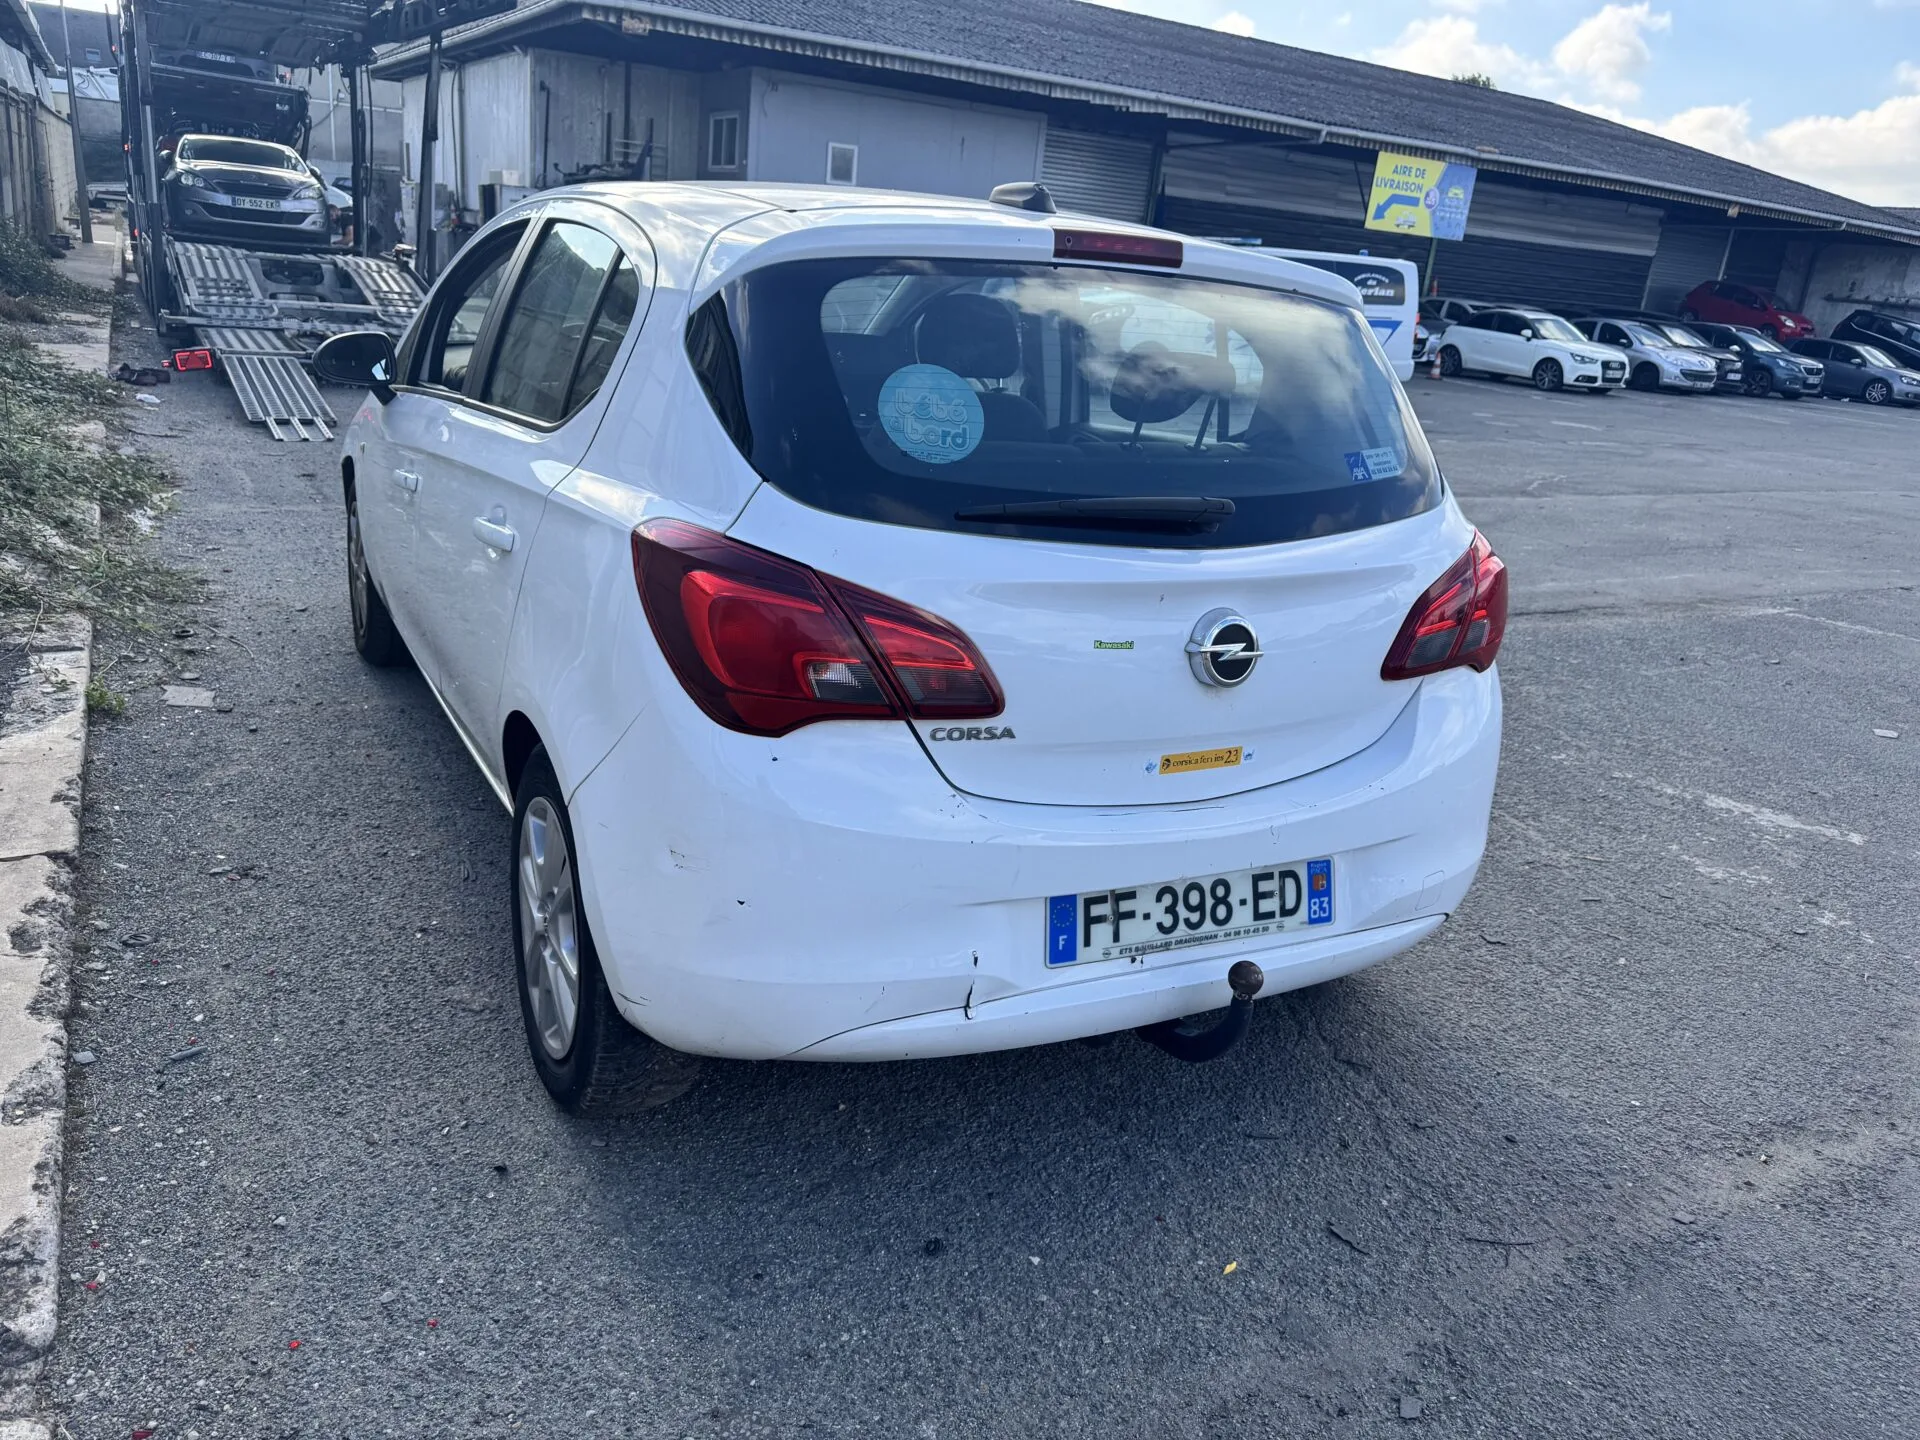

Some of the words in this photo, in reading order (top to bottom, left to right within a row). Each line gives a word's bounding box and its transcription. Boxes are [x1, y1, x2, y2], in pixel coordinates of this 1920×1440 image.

[1392, 164, 1412, 177] AIRE
[1414, 168, 1426, 179] DE
[1375, 176, 1423, 193] LIVRAISON
[1359, 286, 1395, 297] erlan
[904, 415, 969, 450] bord
[1352, 467, 1369, 480] AXA
[1094, 640, 1134, 649] Kawasaki
[929, 726, 1017, 741] CORSA
[1224, 749, 1239, 764] 23
[1083, 869, 1301, 947] FF-398-ED
[1310, 897, 1329, 918] 83
[1058, 935, 1068, 950] F
[1119, 947, 1133, 955] ETS
[1174, 933, 1219, 946] DRAGUIGNAN
[1243, 928, 1251, 936] 10
